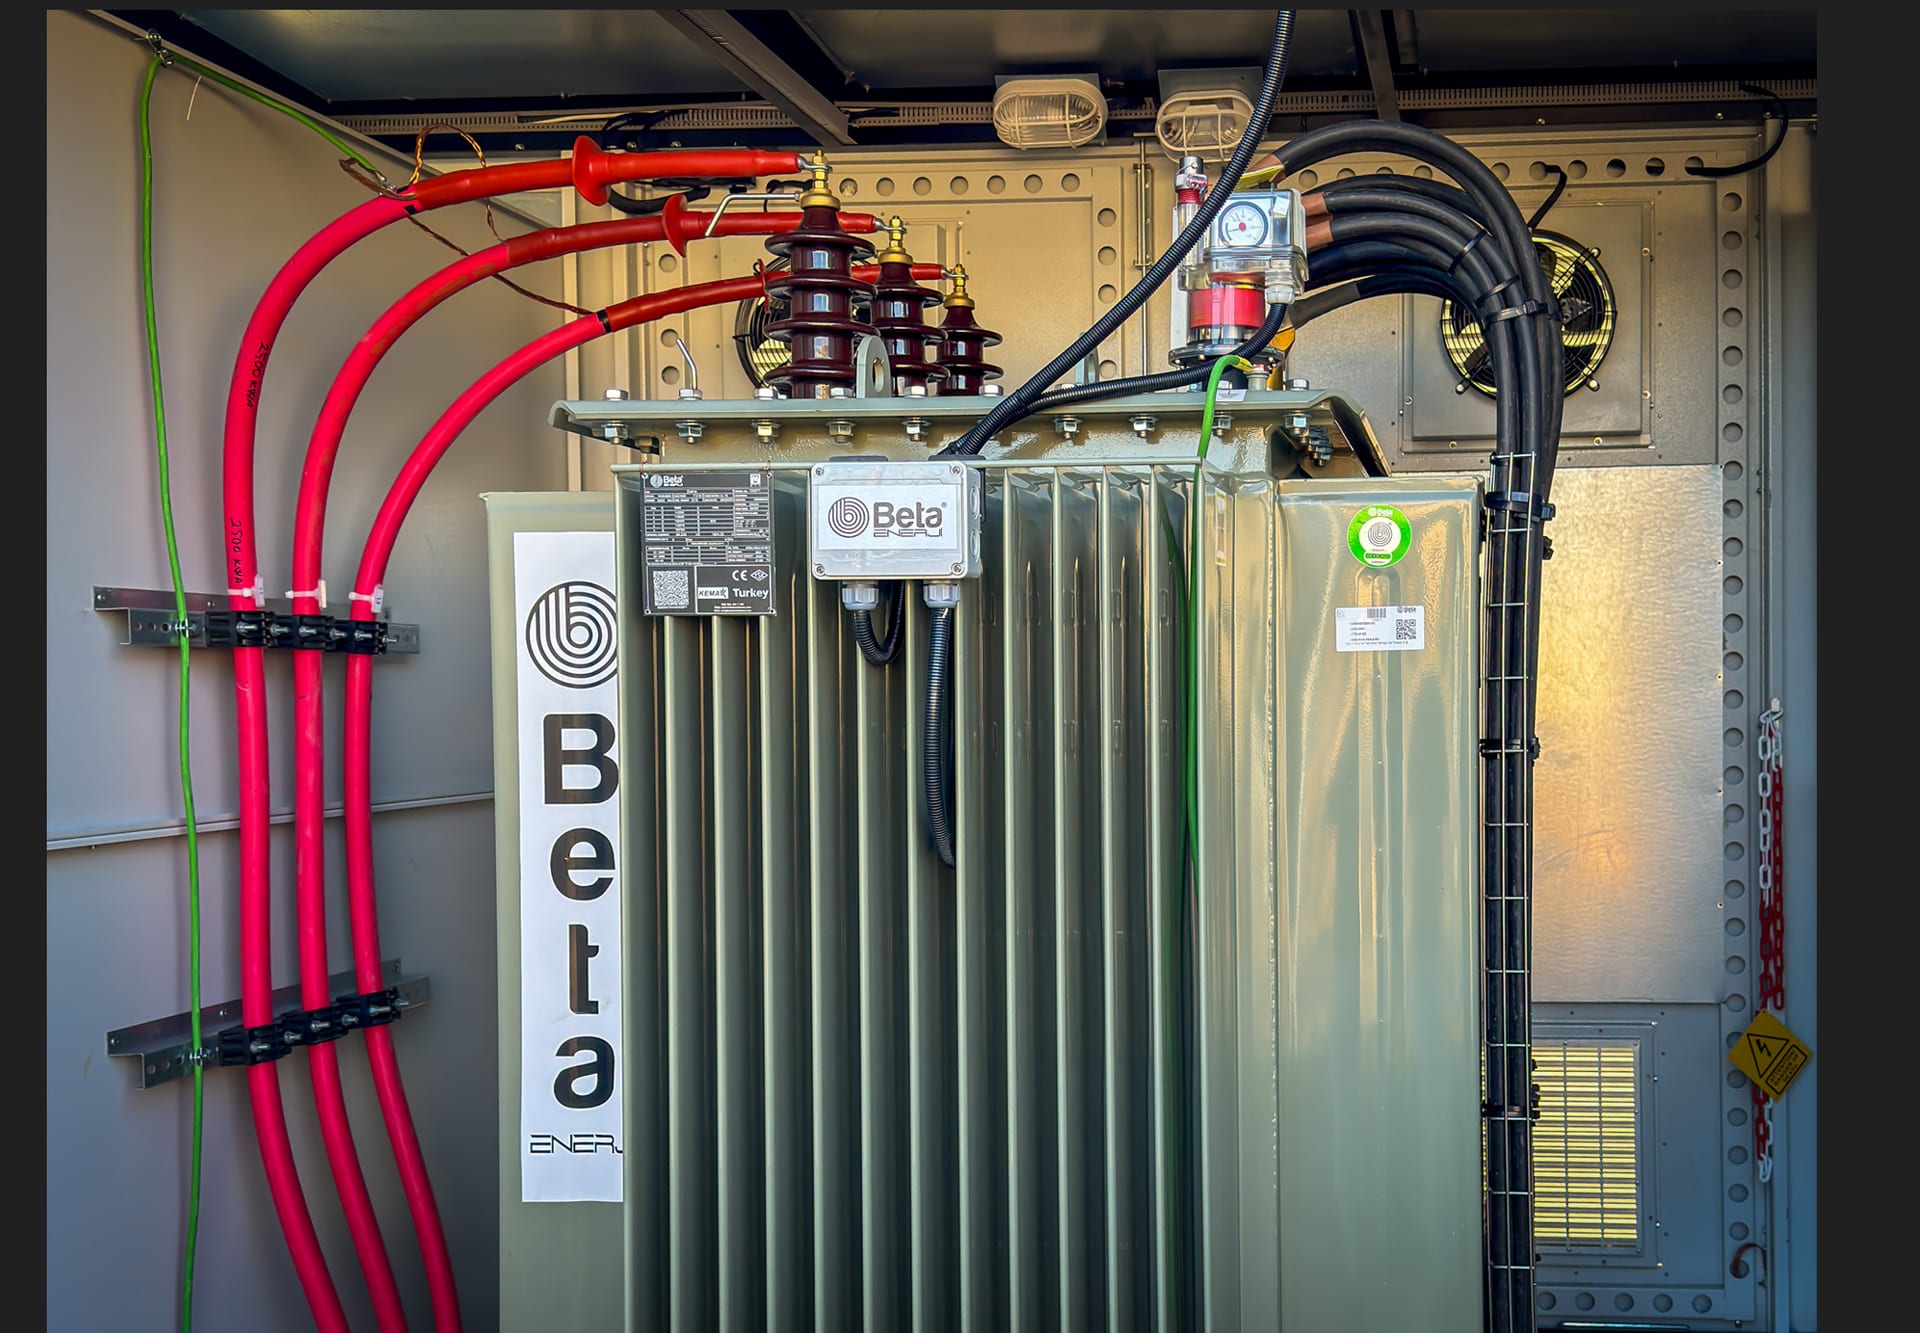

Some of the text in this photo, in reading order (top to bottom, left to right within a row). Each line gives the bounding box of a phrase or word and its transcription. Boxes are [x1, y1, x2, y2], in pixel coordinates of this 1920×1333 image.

[252, 341, 269, 378] 2500
[230, 518, 243, 553] 2500
[732, 570, 748, 581] CE
[732, 587, 769, 599] Turkey
[541, 713, 619, 1110] Beta
